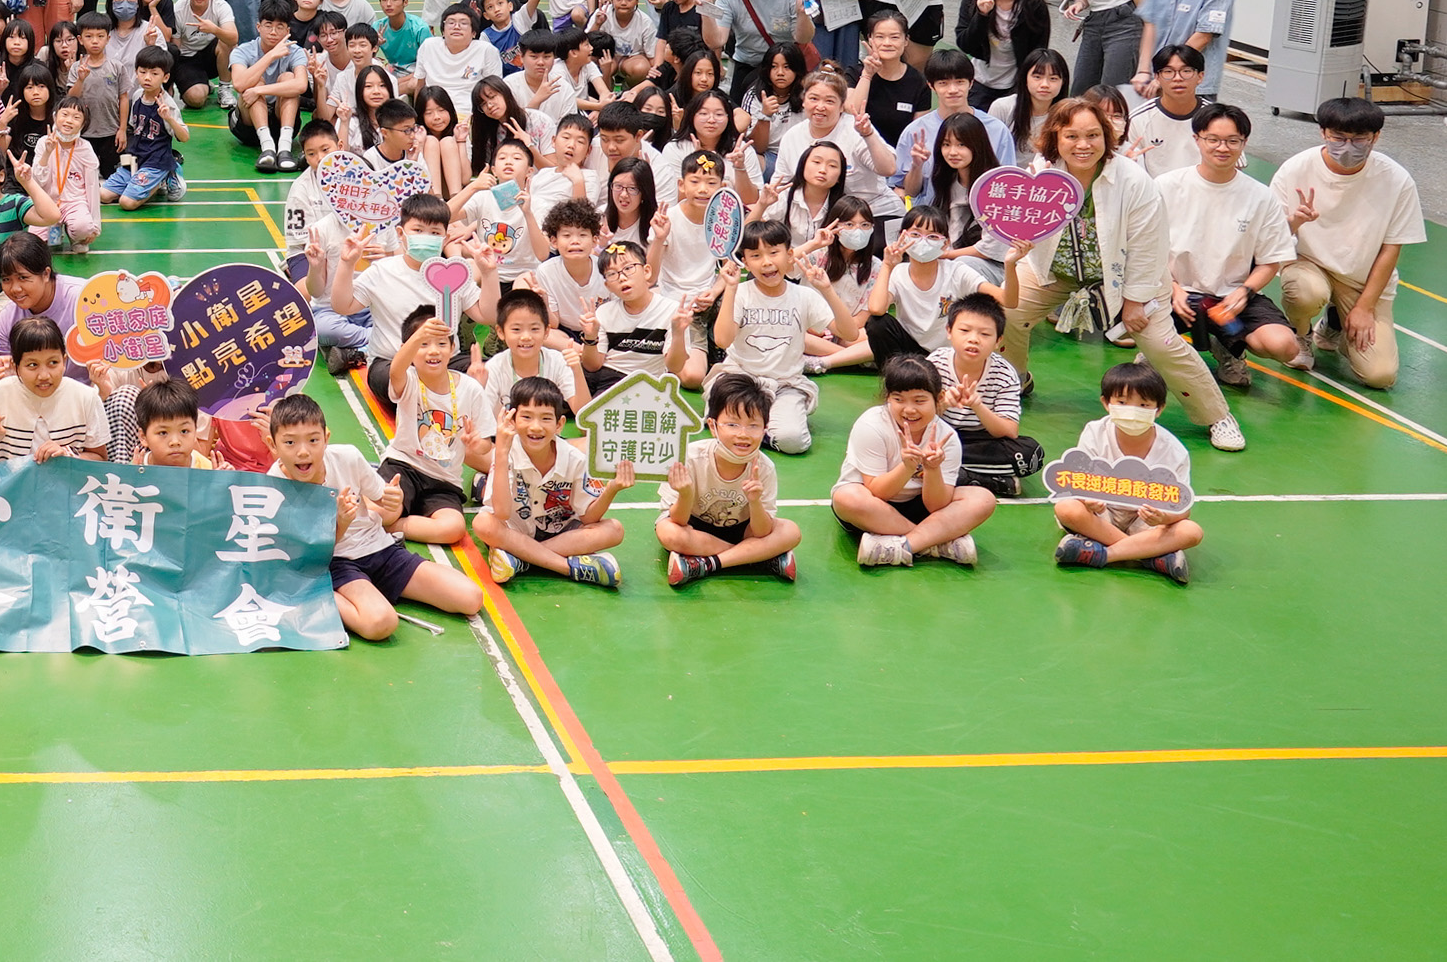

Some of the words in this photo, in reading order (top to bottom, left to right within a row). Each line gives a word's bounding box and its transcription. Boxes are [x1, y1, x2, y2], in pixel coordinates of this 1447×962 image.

[339, 183, 372, 199] 好日子
[987, 181, 1069, 205] 攜手協力
[983, 202, 1063, 226] 守護兒少
[85, 304, 170, 335] 守護家庭
[180, 279, 272, 350] 小衛星
[739, 307, 802, 333] BELUGA
[103, 332, 167, 363] 小衛星
[180, 301, 307, 390] 點亮希望
[603, 409, 677, 435] 群星圍繞
[602, 439, 675, 464] 守護兒少
[1055, 470, 1181, 504] 不畏逆境勇敢發光
